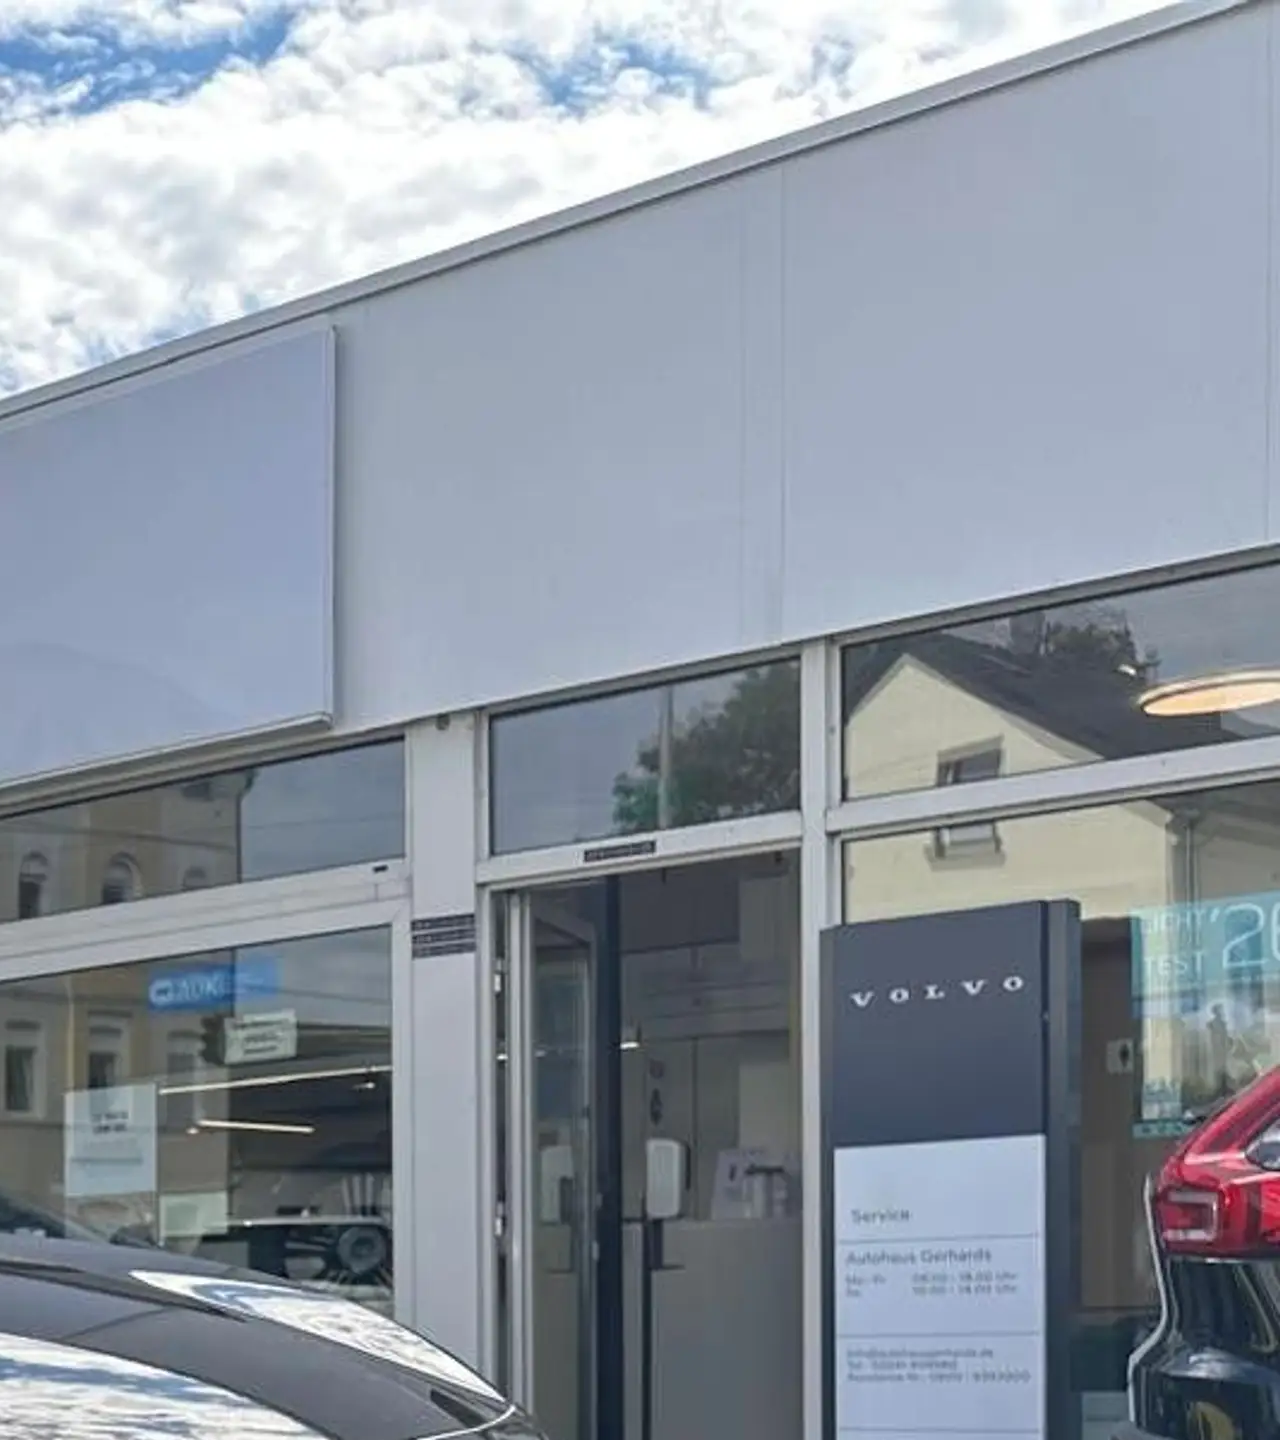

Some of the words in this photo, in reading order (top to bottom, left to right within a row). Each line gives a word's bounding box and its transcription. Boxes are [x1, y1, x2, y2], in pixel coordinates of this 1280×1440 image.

[850, 974, 1024, 1007] VOLVO
[850, 1208, 911, 1225] Service
[845, 1250, 916, 1266] Autohaus
[920, 1248, 992, 1265] Gerhards
